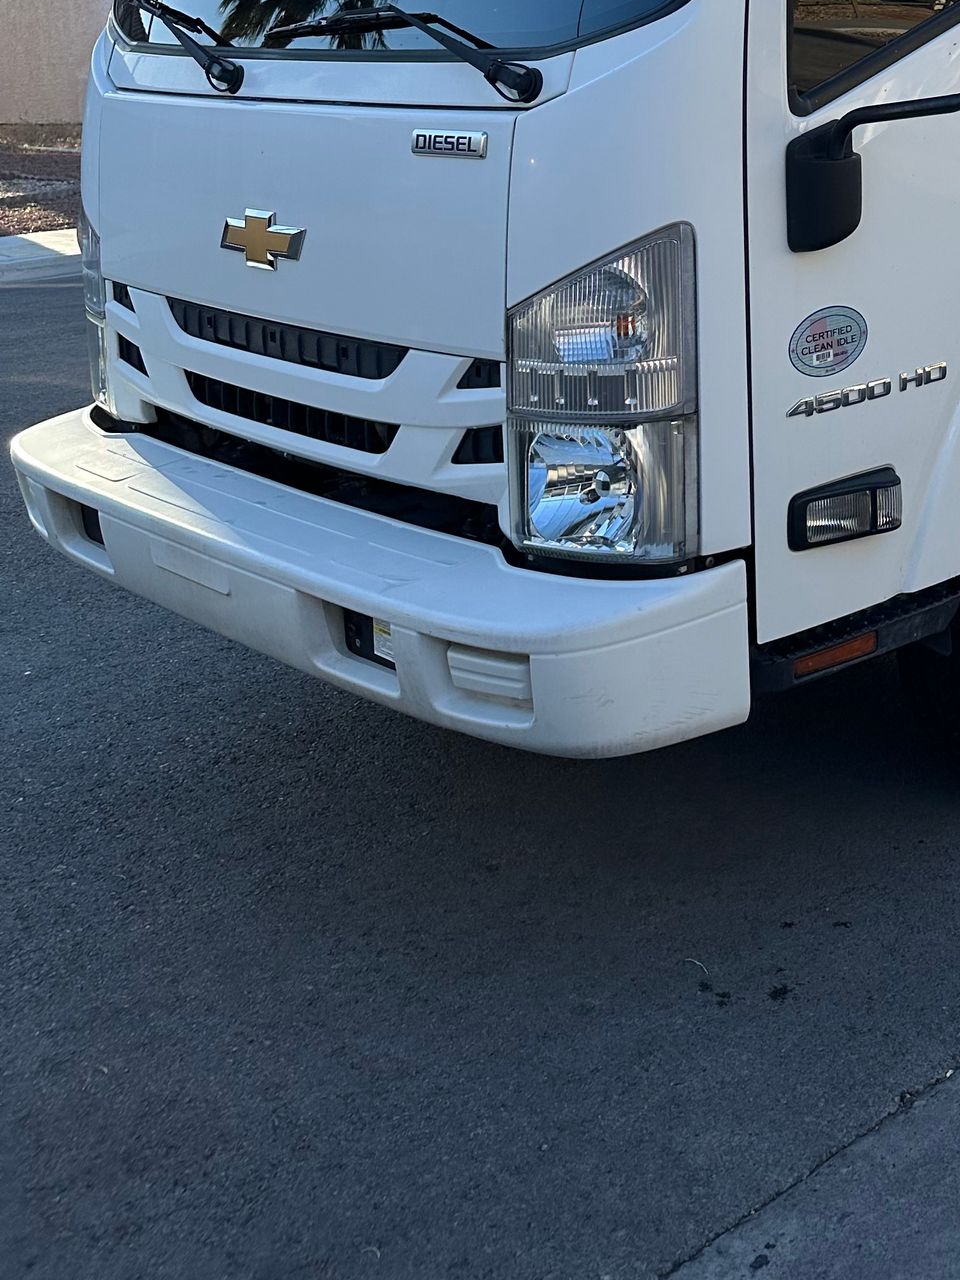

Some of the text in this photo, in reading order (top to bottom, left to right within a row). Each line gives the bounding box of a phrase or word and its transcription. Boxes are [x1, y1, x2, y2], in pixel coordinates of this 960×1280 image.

[415, 133, 477, 153] DIESEL
[805, 324, 853, 344] CERTIFIED
[801, 341, 834, 356] CLEAN
[836, 334, 858, 347] IDLE
[785, 360, 948, 418] 4500 HD
